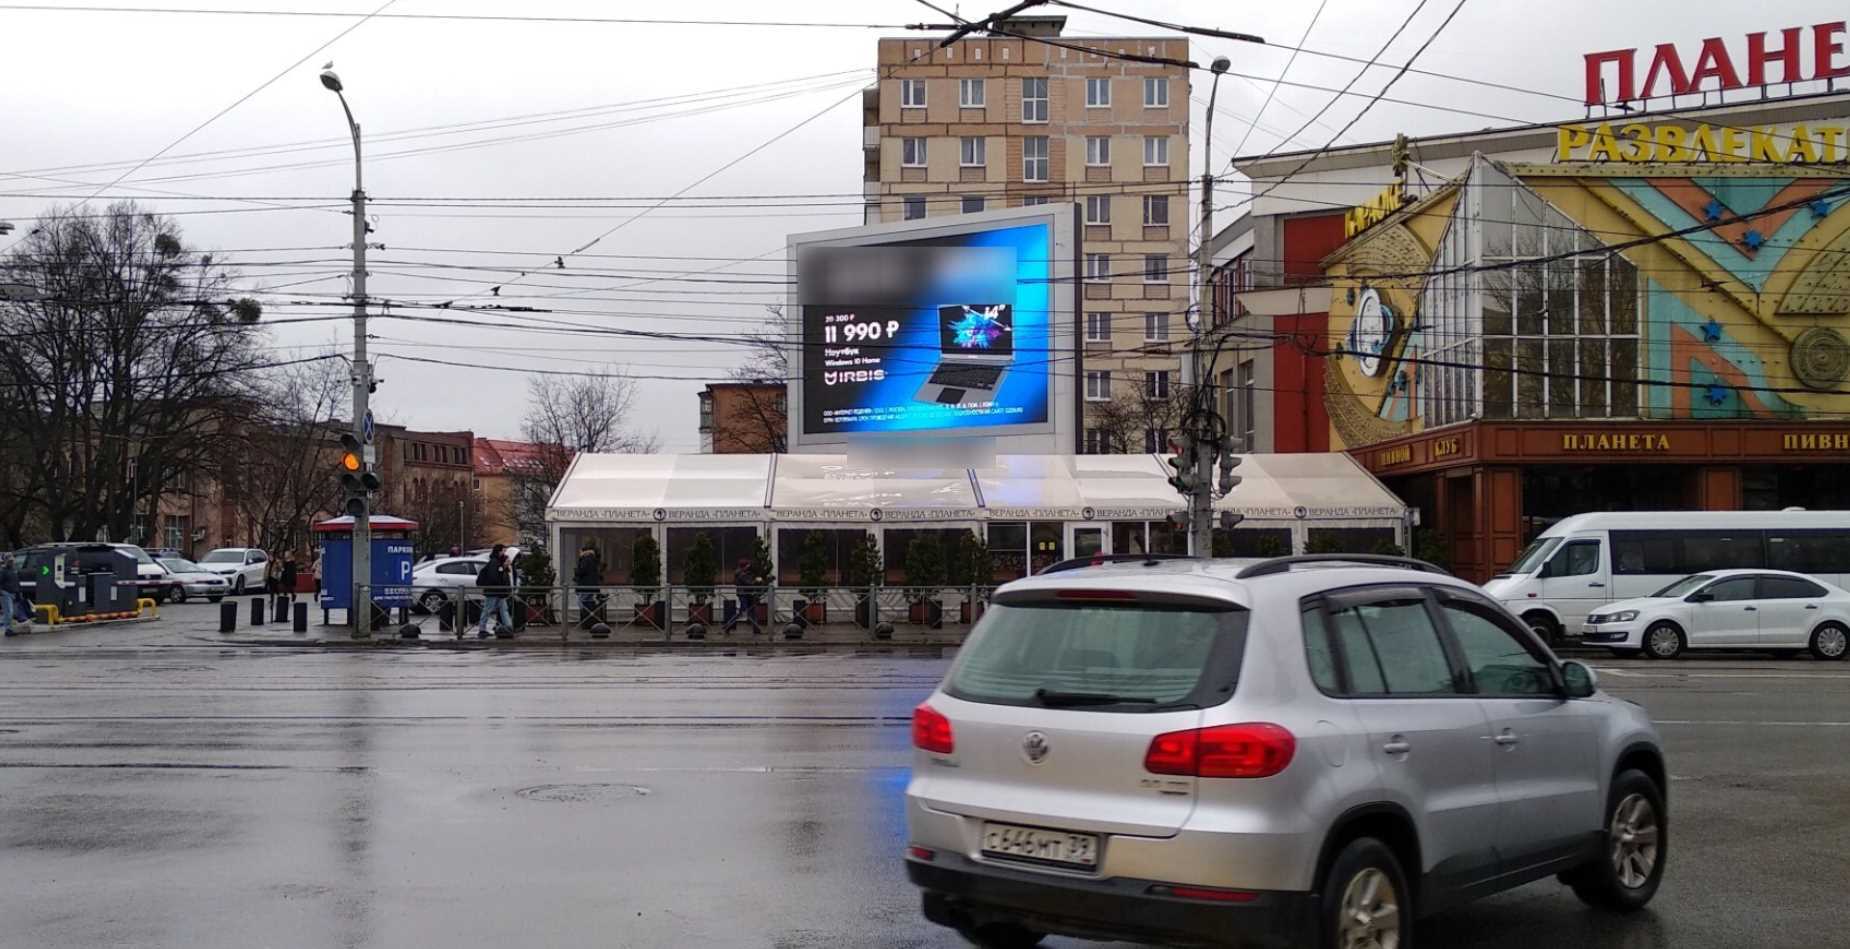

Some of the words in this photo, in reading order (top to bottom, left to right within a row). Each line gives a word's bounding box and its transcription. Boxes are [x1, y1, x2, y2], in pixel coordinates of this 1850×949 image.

[1583, 20, 1850, 107] ПЛАНЕ
[1558, 123, 1850, 163] РАЗВЛЕКАТ
[825, 325, 837, 343] 11
[843, 321, 881, 342] 990
[885, 320, 899, 338] ₽
[825, 347, 859, 358] Ноутбук
[861, 357, 880, 365] Home
[839, 369, 885, 383] IRBIS
[1563, 434, 1671, 450] ПЛАНЕТА
[1783, 434, 1850, 450] ПИВН
[401, 561, 411, 580] P
